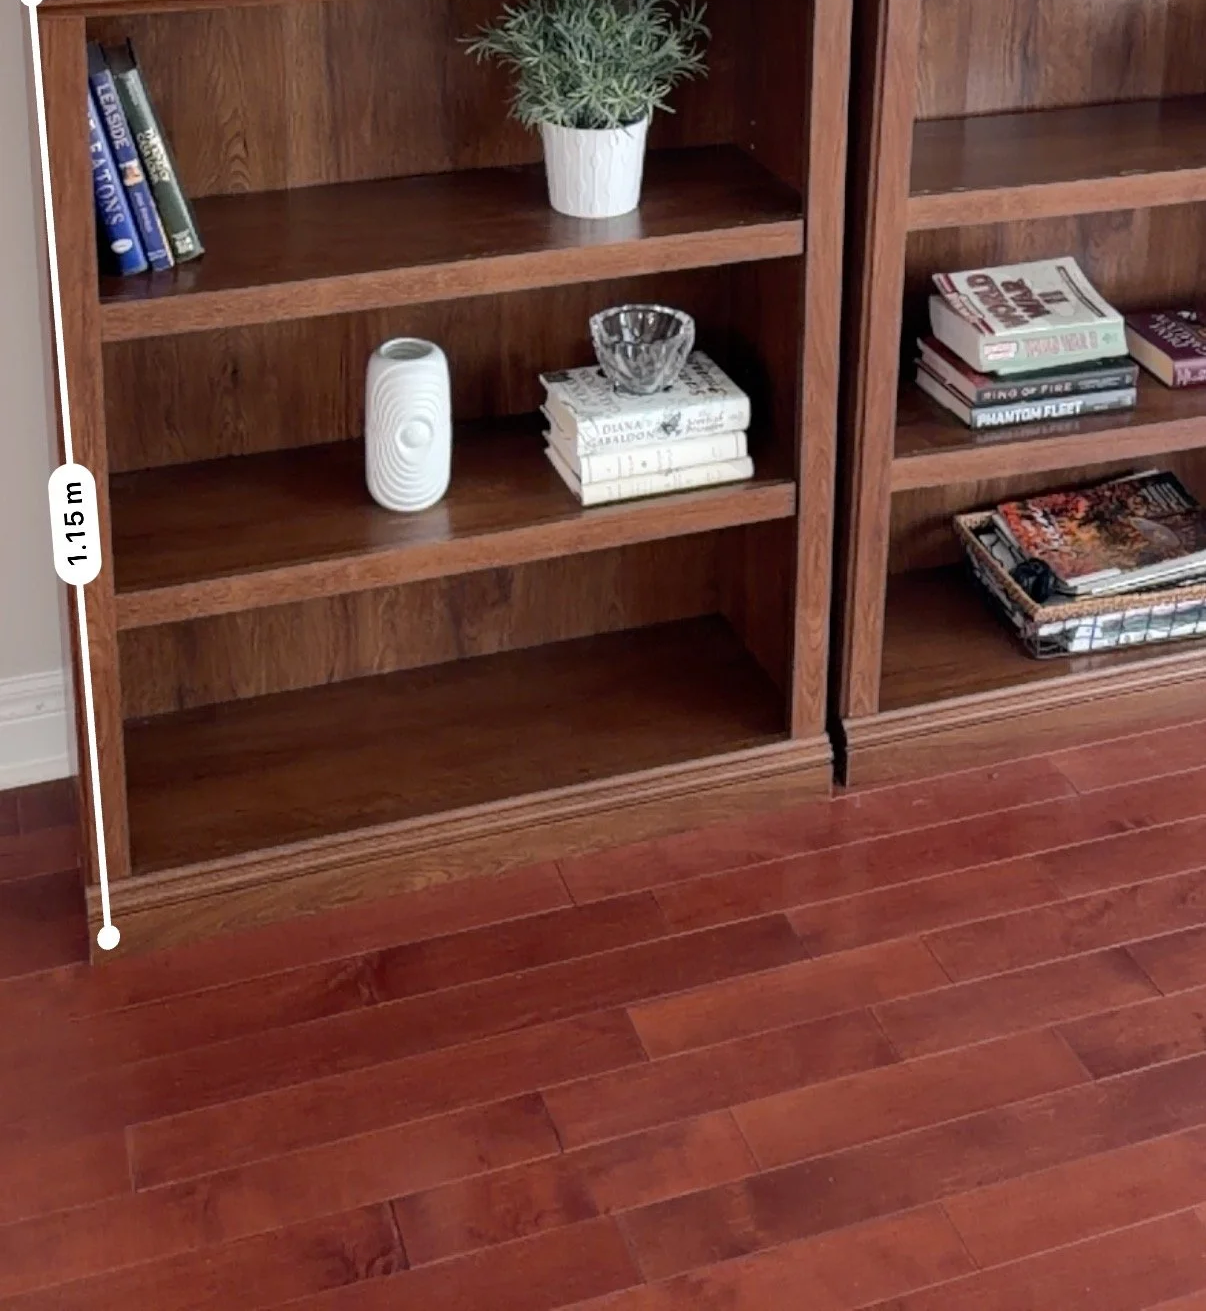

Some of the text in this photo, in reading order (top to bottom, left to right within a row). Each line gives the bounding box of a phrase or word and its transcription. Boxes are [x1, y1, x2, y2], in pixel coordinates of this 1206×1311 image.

[97, 85, 131, 151] LEASIDE
[966, 274, 1030, 329] WORLD
[1001, 278, 1052, 319] WAR
[1038, 288, 1071, 304] II
[982, 387, 1018, 401] RING
[1021, 386, 1037, 397] OF
[1041, 382, 1073, 395] FIRE
[603, 422, 643, 434] DIANA
[976, 400, 1084, 428] PHANTOM FLEET
